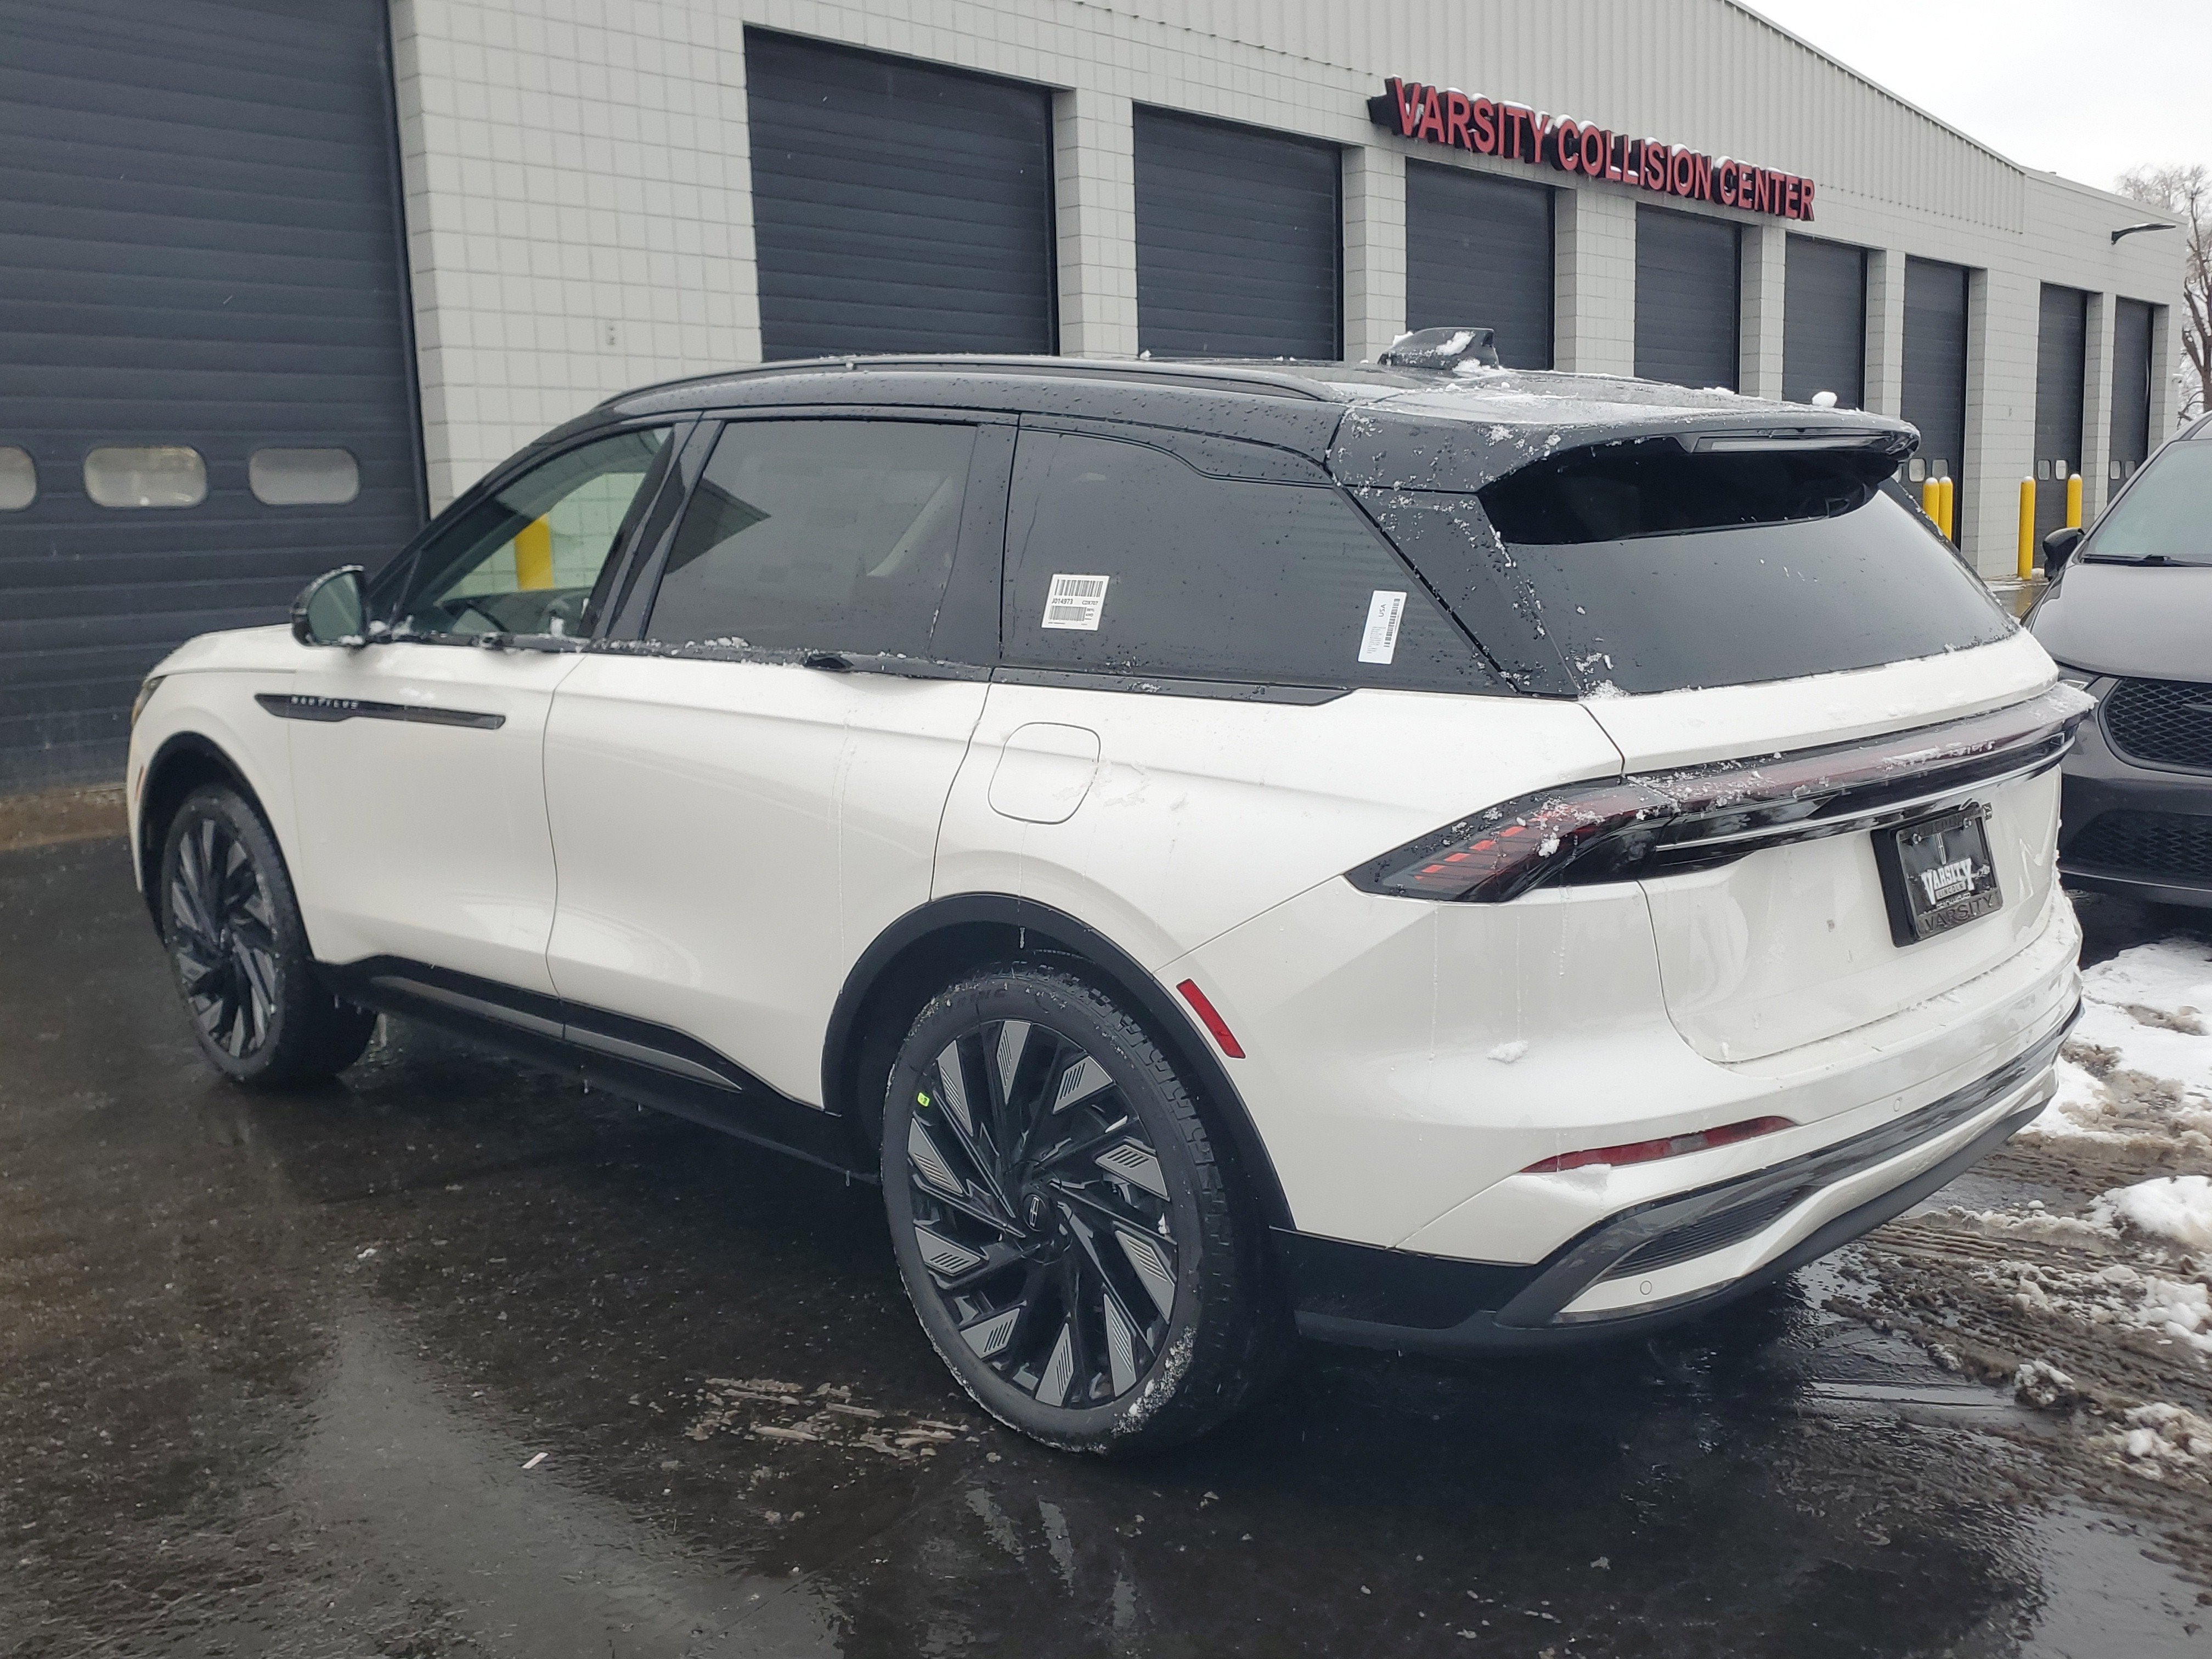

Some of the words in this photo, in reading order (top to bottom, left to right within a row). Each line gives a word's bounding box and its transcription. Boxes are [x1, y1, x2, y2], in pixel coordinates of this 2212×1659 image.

[1394, 77, 1550, 163] VARSITY
[1558, 119, 1712, 200] COLLISION
[1720, 159, 1815, 222] CENTER
[1378, 604, 1386, 617] USA
[1921, 857, 1975, 905] VARSITY
[1938, 883, 1963, 898] LINCOLN
[1925, 894, 1993, 930] VARSITY
